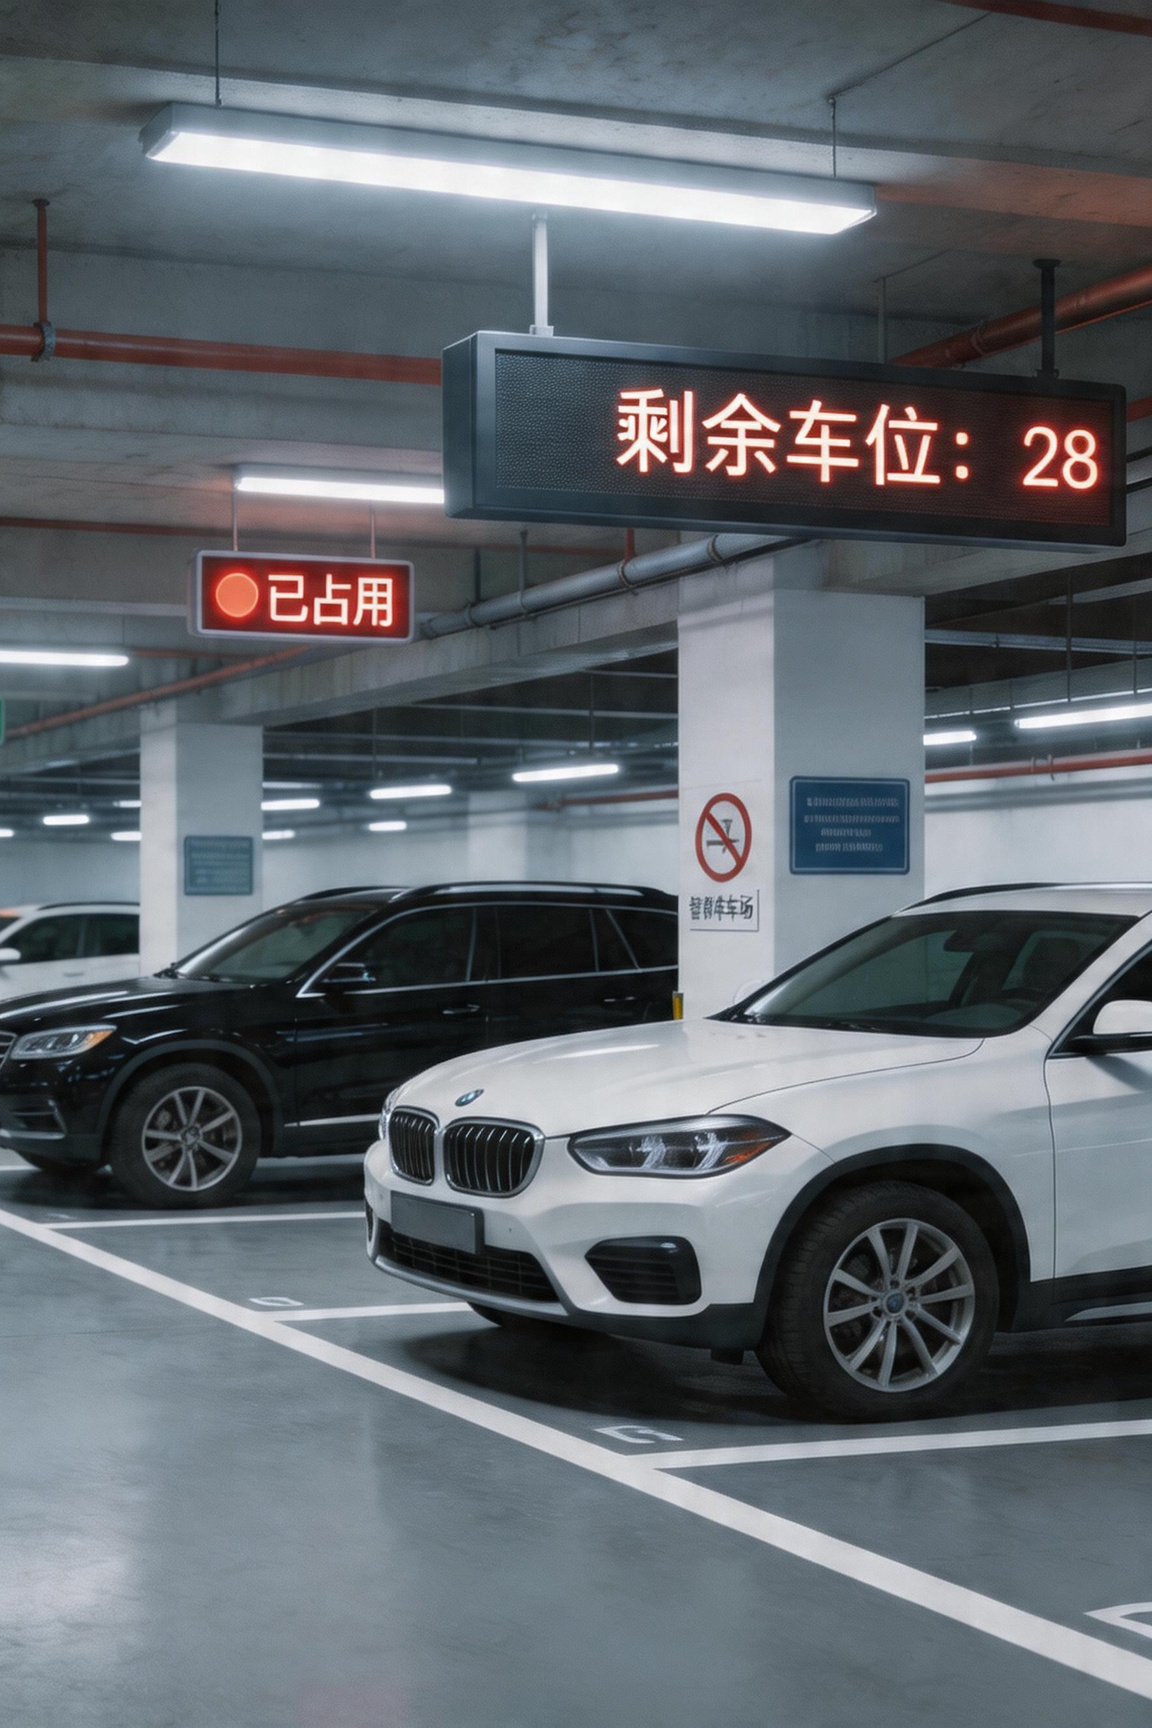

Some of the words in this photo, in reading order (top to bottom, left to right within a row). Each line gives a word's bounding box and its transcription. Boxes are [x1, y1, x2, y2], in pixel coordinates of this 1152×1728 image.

[1022, 426, 1098, 489] 28
[268, 574, 393, 627] 已占用
